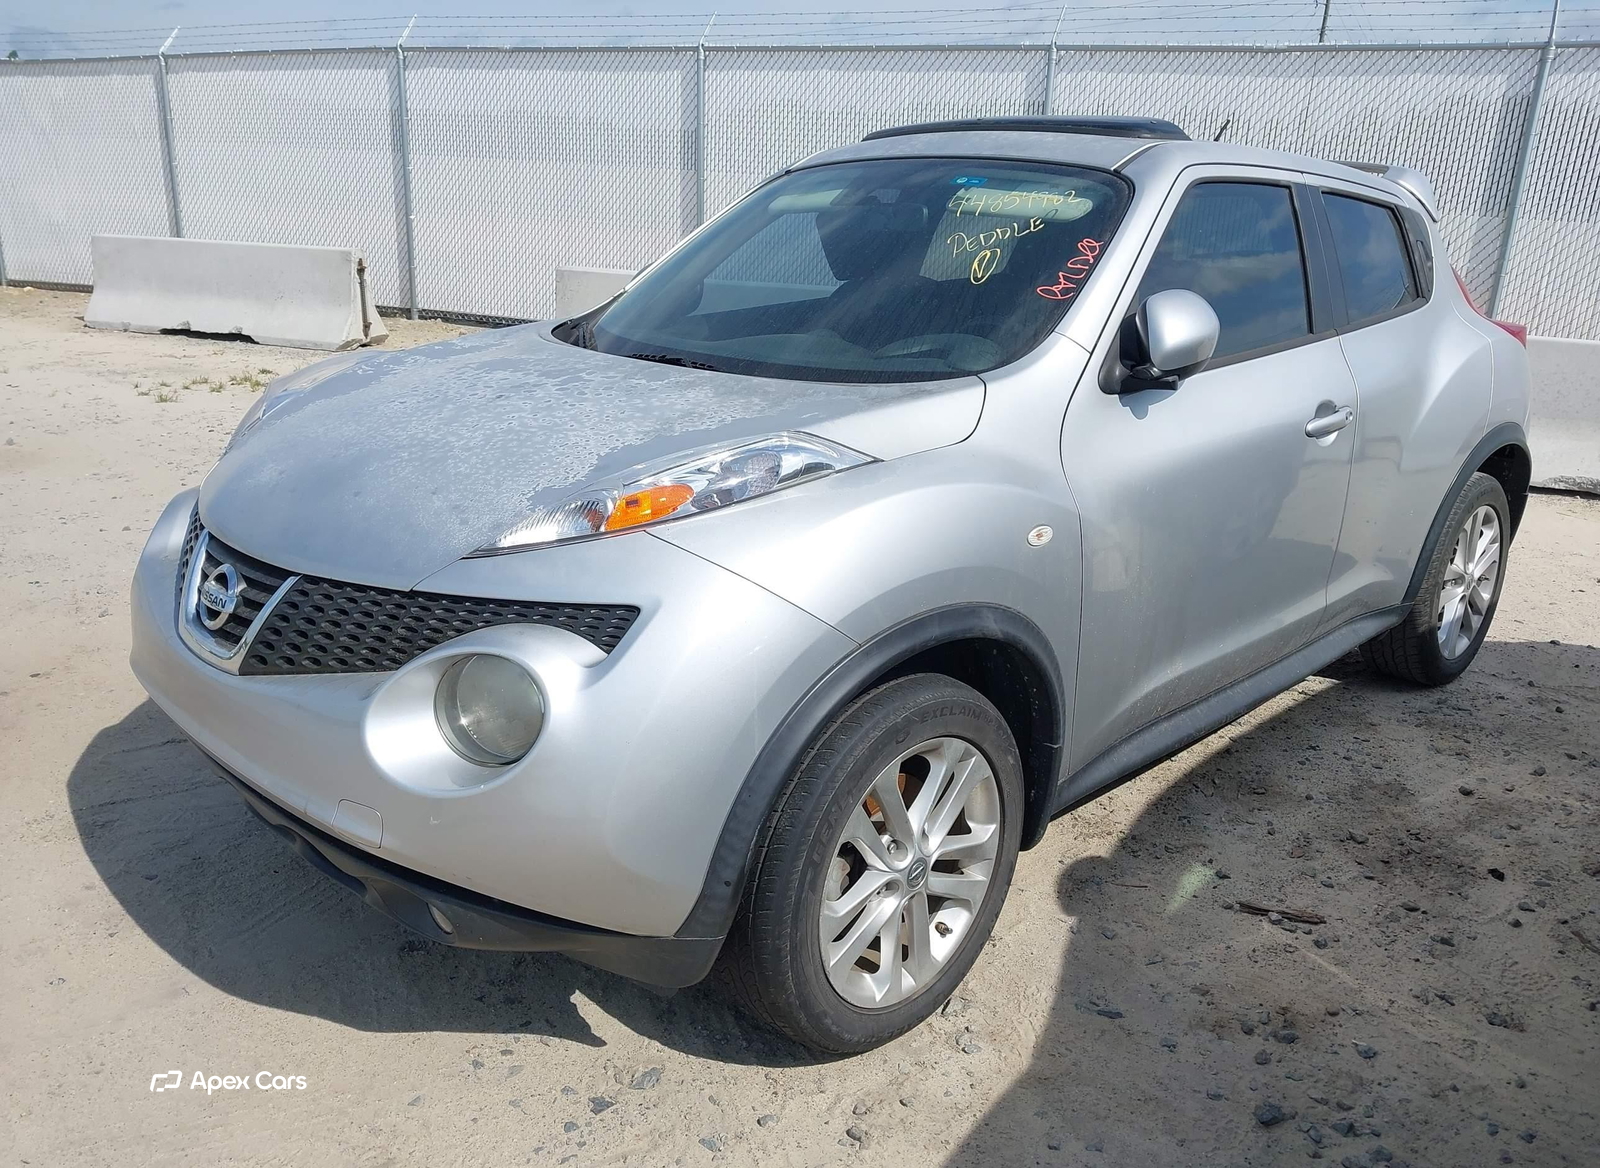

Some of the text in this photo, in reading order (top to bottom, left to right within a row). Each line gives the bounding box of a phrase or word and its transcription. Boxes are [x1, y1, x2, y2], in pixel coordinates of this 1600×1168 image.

[948, 216, 1045, 258] PEDDLE
[202, 587, 227, 609] SSAN
[922, 705, 982, 726] EXCLAIM
